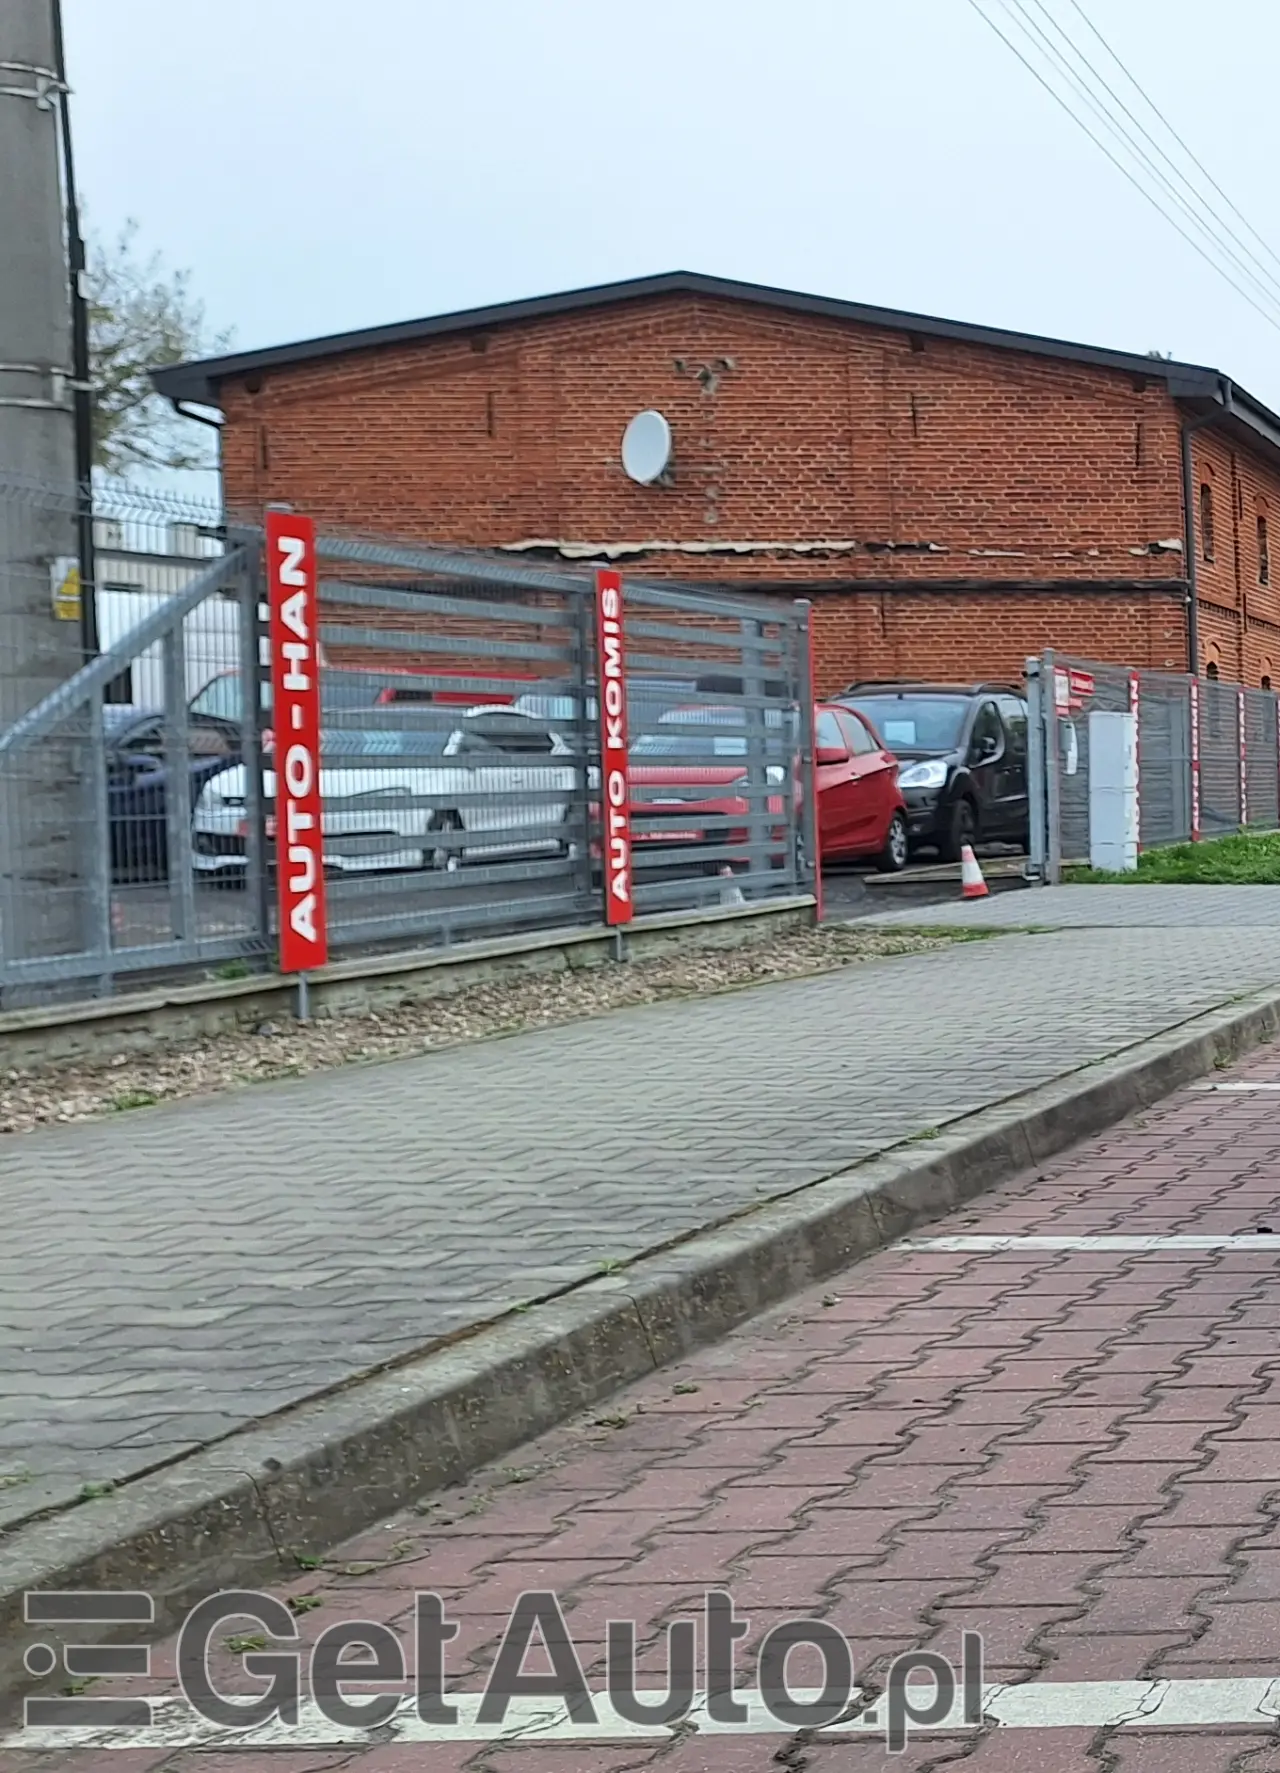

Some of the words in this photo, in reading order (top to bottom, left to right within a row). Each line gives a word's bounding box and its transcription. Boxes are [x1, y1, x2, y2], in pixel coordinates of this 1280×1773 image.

[278, 535, 310, 692] HAN
[603, 586, 624, 750] KOMIS
[287, 743, 318, 944] AUTO
[608, 770, 629, 902] AUTO
